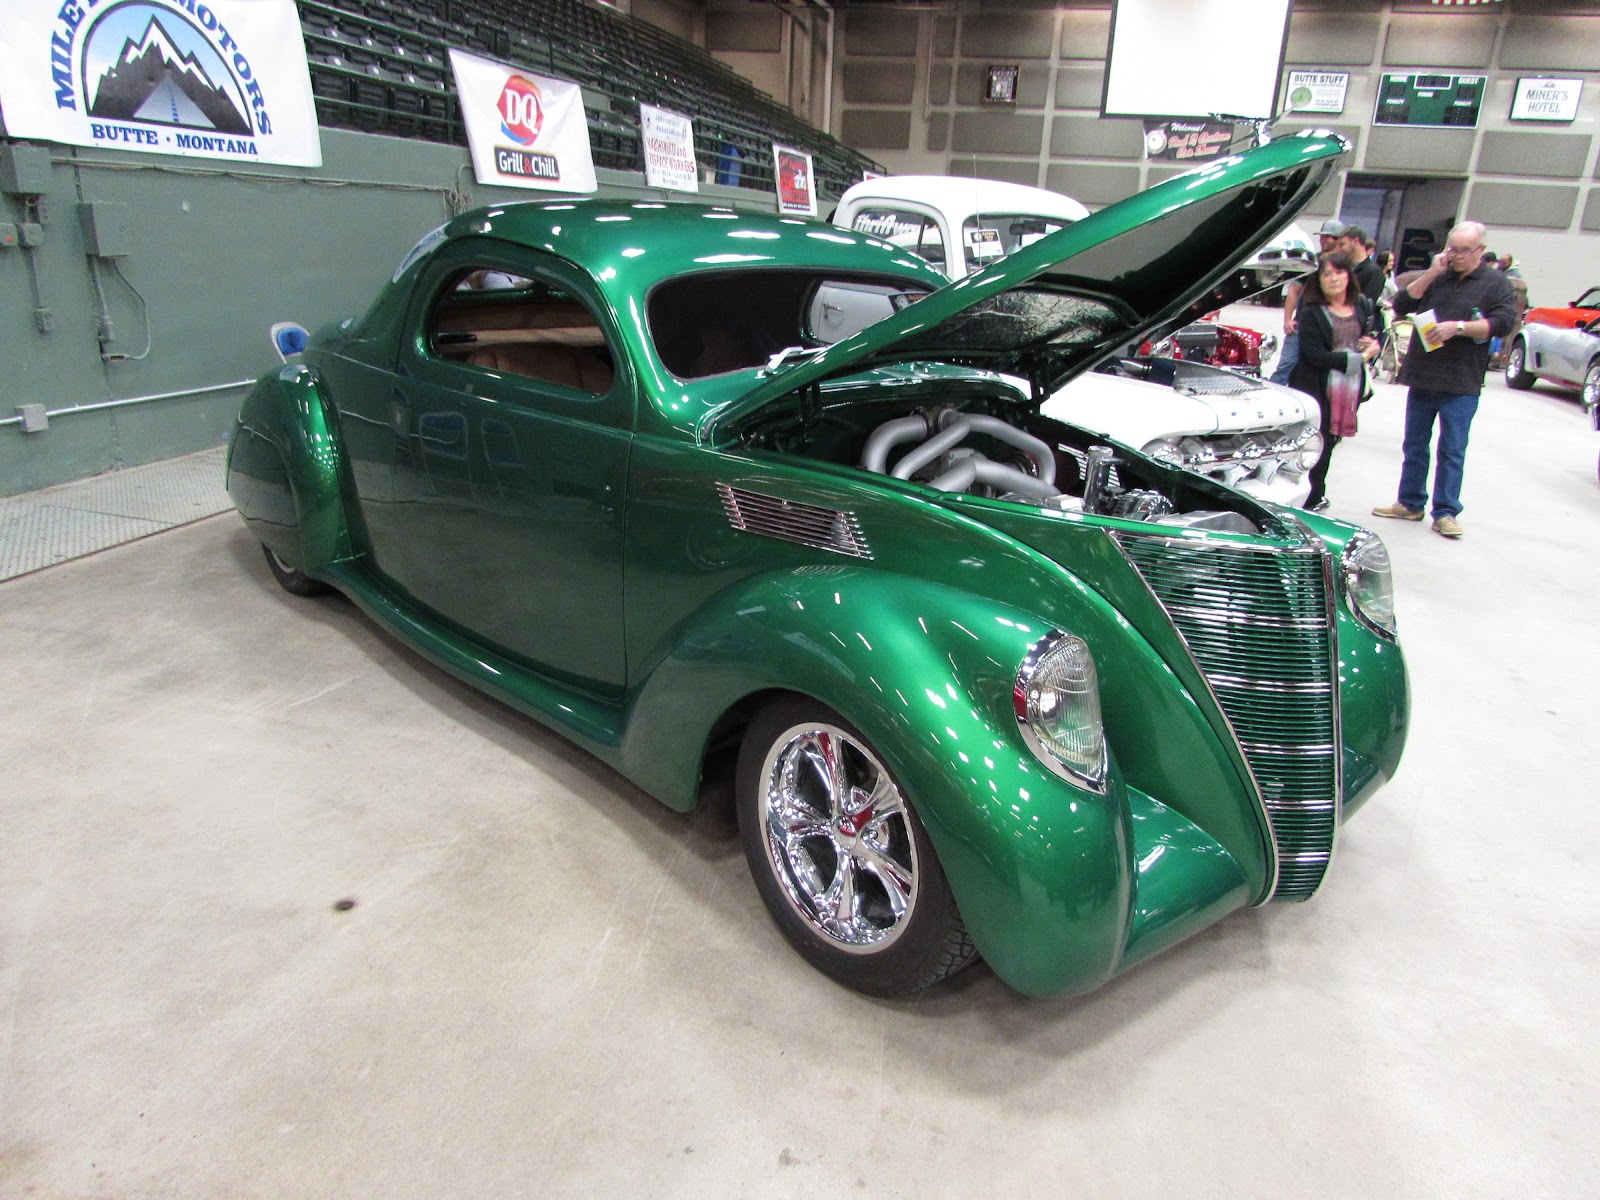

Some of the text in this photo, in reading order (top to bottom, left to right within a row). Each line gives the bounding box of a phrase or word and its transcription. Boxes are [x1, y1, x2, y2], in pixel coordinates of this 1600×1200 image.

[51, 0, 272, 135] MILE MOTORS
[1294, 74, 1345, 84] BUTTE STUFF
[1389, 75, 1408, 83] HOME
[1458, 77, 1479, 85] GUEST
[1526, 90, 1569, 101] MINER'S
[505, 88, 539, 135] DQ
[1528, 102, 1561, 113] HOTEL
[1171, 122, 1206, 132] Welcome!
[91, 123, 258, 155] BUTTE MONTANA
